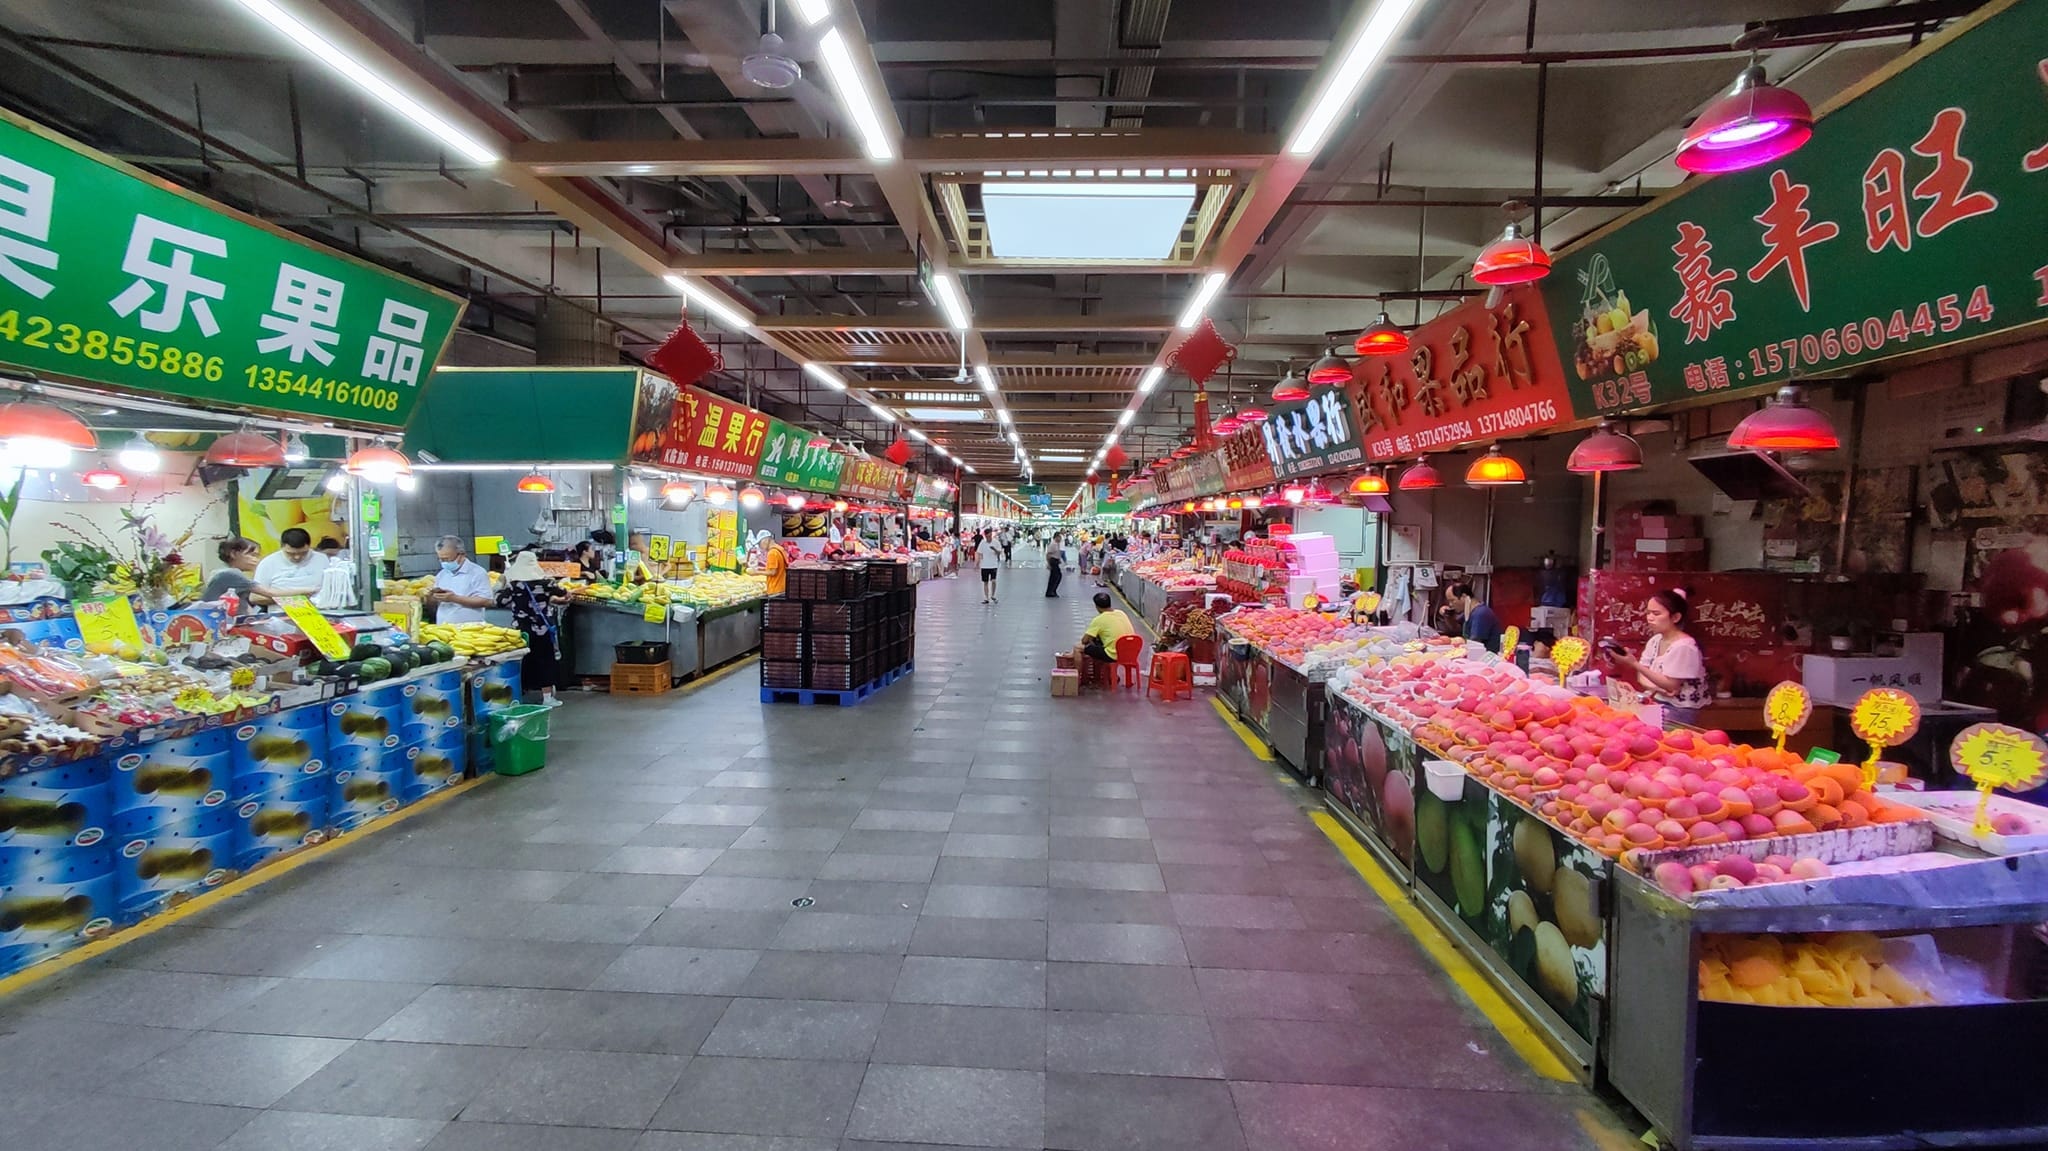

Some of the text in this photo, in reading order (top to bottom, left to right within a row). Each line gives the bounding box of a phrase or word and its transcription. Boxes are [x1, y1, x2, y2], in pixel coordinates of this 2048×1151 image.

[1670, 59, 2048, 344] 嘉丰旺
[243, 364, 398, 412] 13544161008
[1593, 370, 1652, 410] K32号
[1371, 438, 1394, 456] K33号
[1477, 399, 1557, 434] 13714804766
[1869, 712, 1891, 729] 7.5
